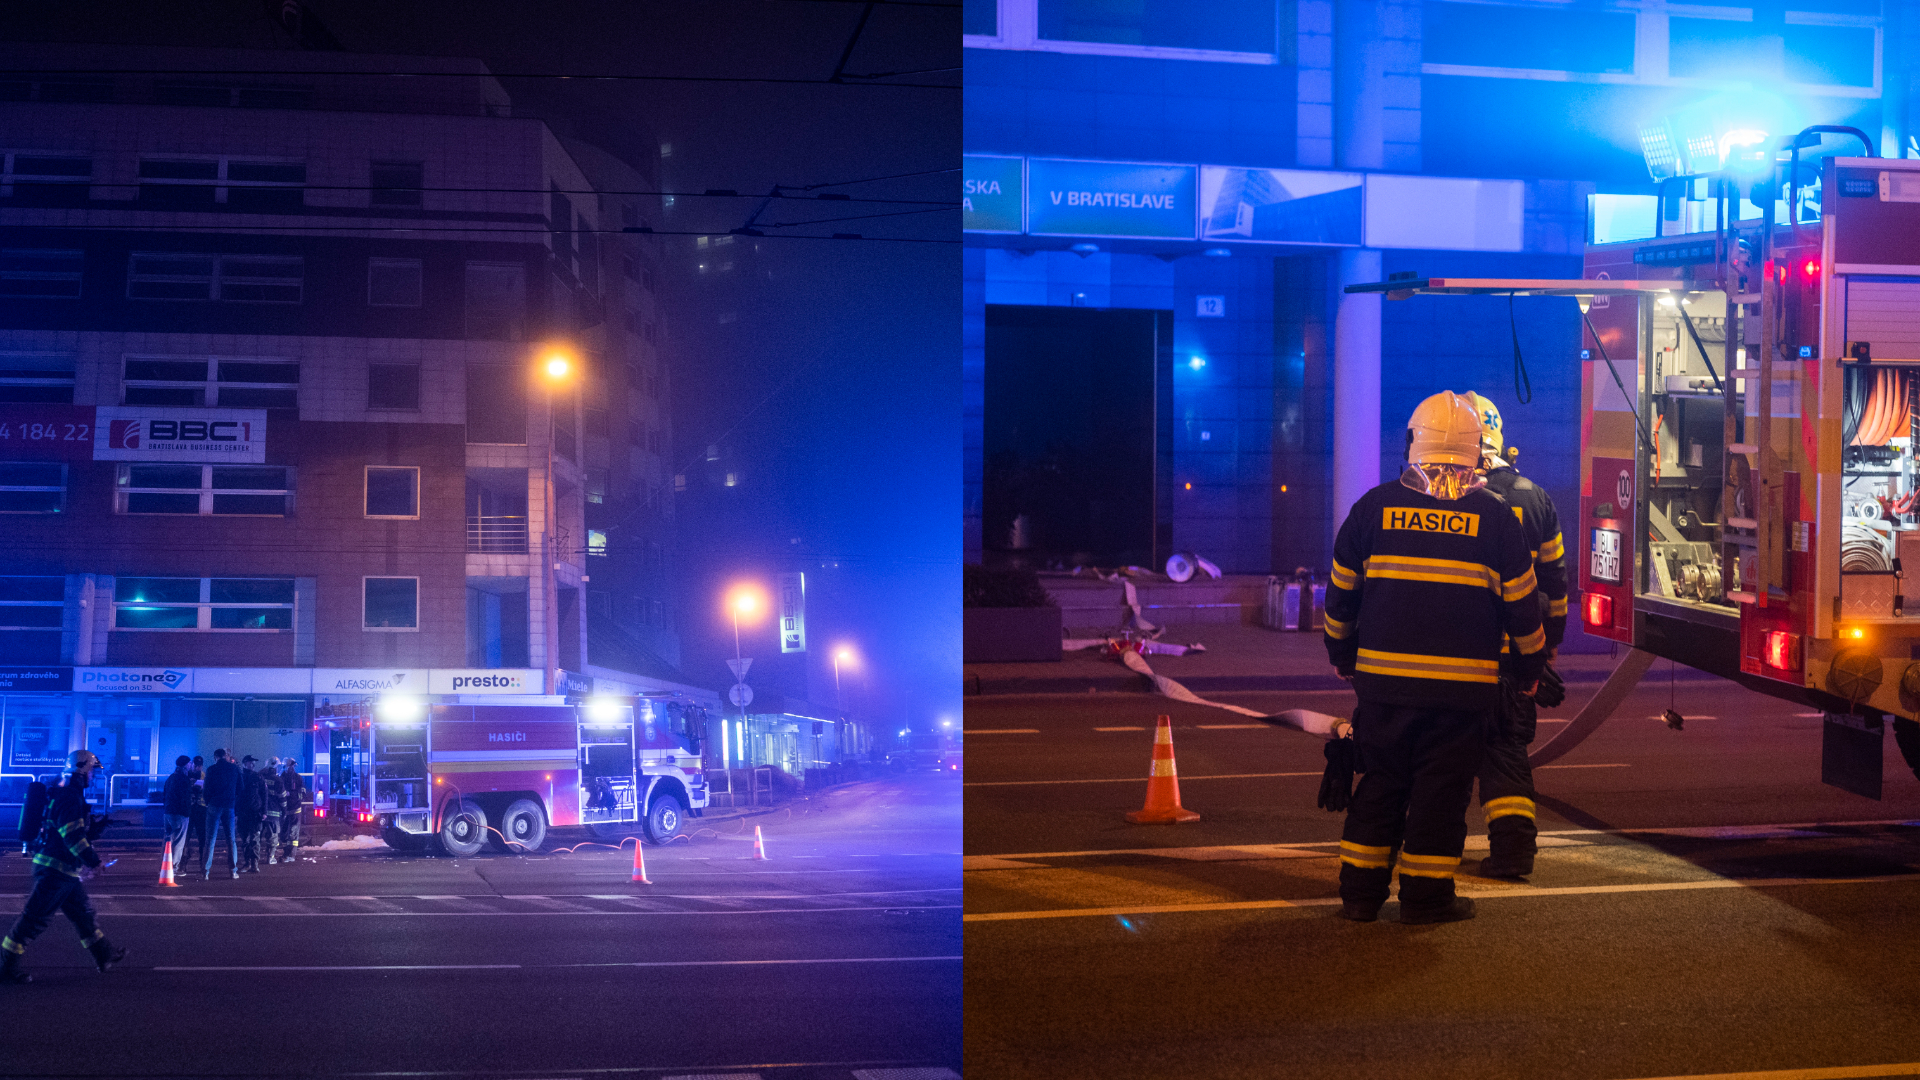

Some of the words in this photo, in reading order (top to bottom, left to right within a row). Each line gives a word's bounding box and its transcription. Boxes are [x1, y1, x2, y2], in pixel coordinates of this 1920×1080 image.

[963, 179, 1001, 195] SKA
[1050, 190, 1063, 205] V
[1068, 191, 1175, 210] BRATISLAVE
[1204, 300, 1216, 312] 12
[19, 423, 56, 440] 184
[63, 424, 89, 441] 22
[149, 420, 251, 441] BBC1
[1619, 475, 1631, 498] 100
[1391, 511, 1471, 535] HASIČI
[1601, 533, 1611, 554] BL
[1593, 554, 1619, 577] 751HZ
[20, 671, 60, 679] zdravého
[335, 679, 393, 690] ALFASIGMA
[568, 679, 588, 693] Miele
[489, 731, 527, 742] HASIČI
